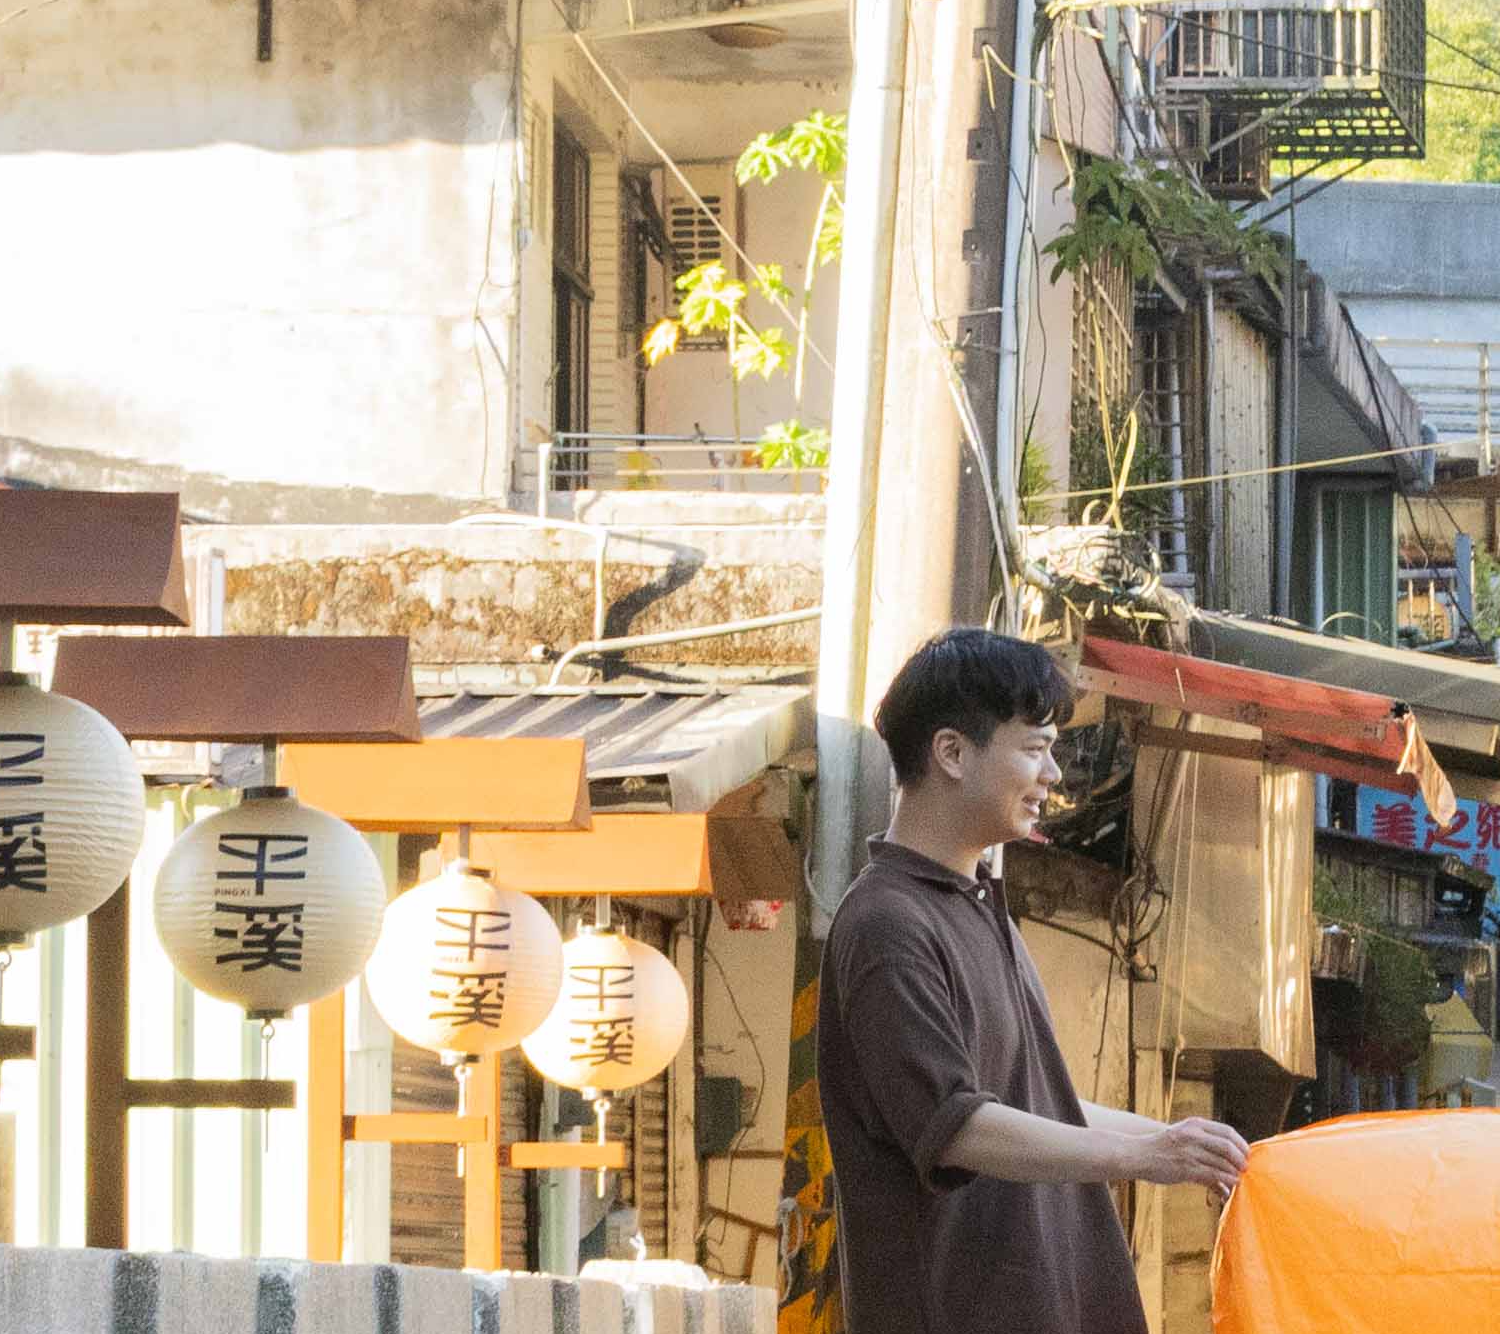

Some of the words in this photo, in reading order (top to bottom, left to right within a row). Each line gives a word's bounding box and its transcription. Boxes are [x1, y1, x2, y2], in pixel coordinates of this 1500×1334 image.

[213, 833, 309, 974] 平溪
[429, 907, 511, 1029] 平溪
[569, 965, 635, 1067] 平溪
